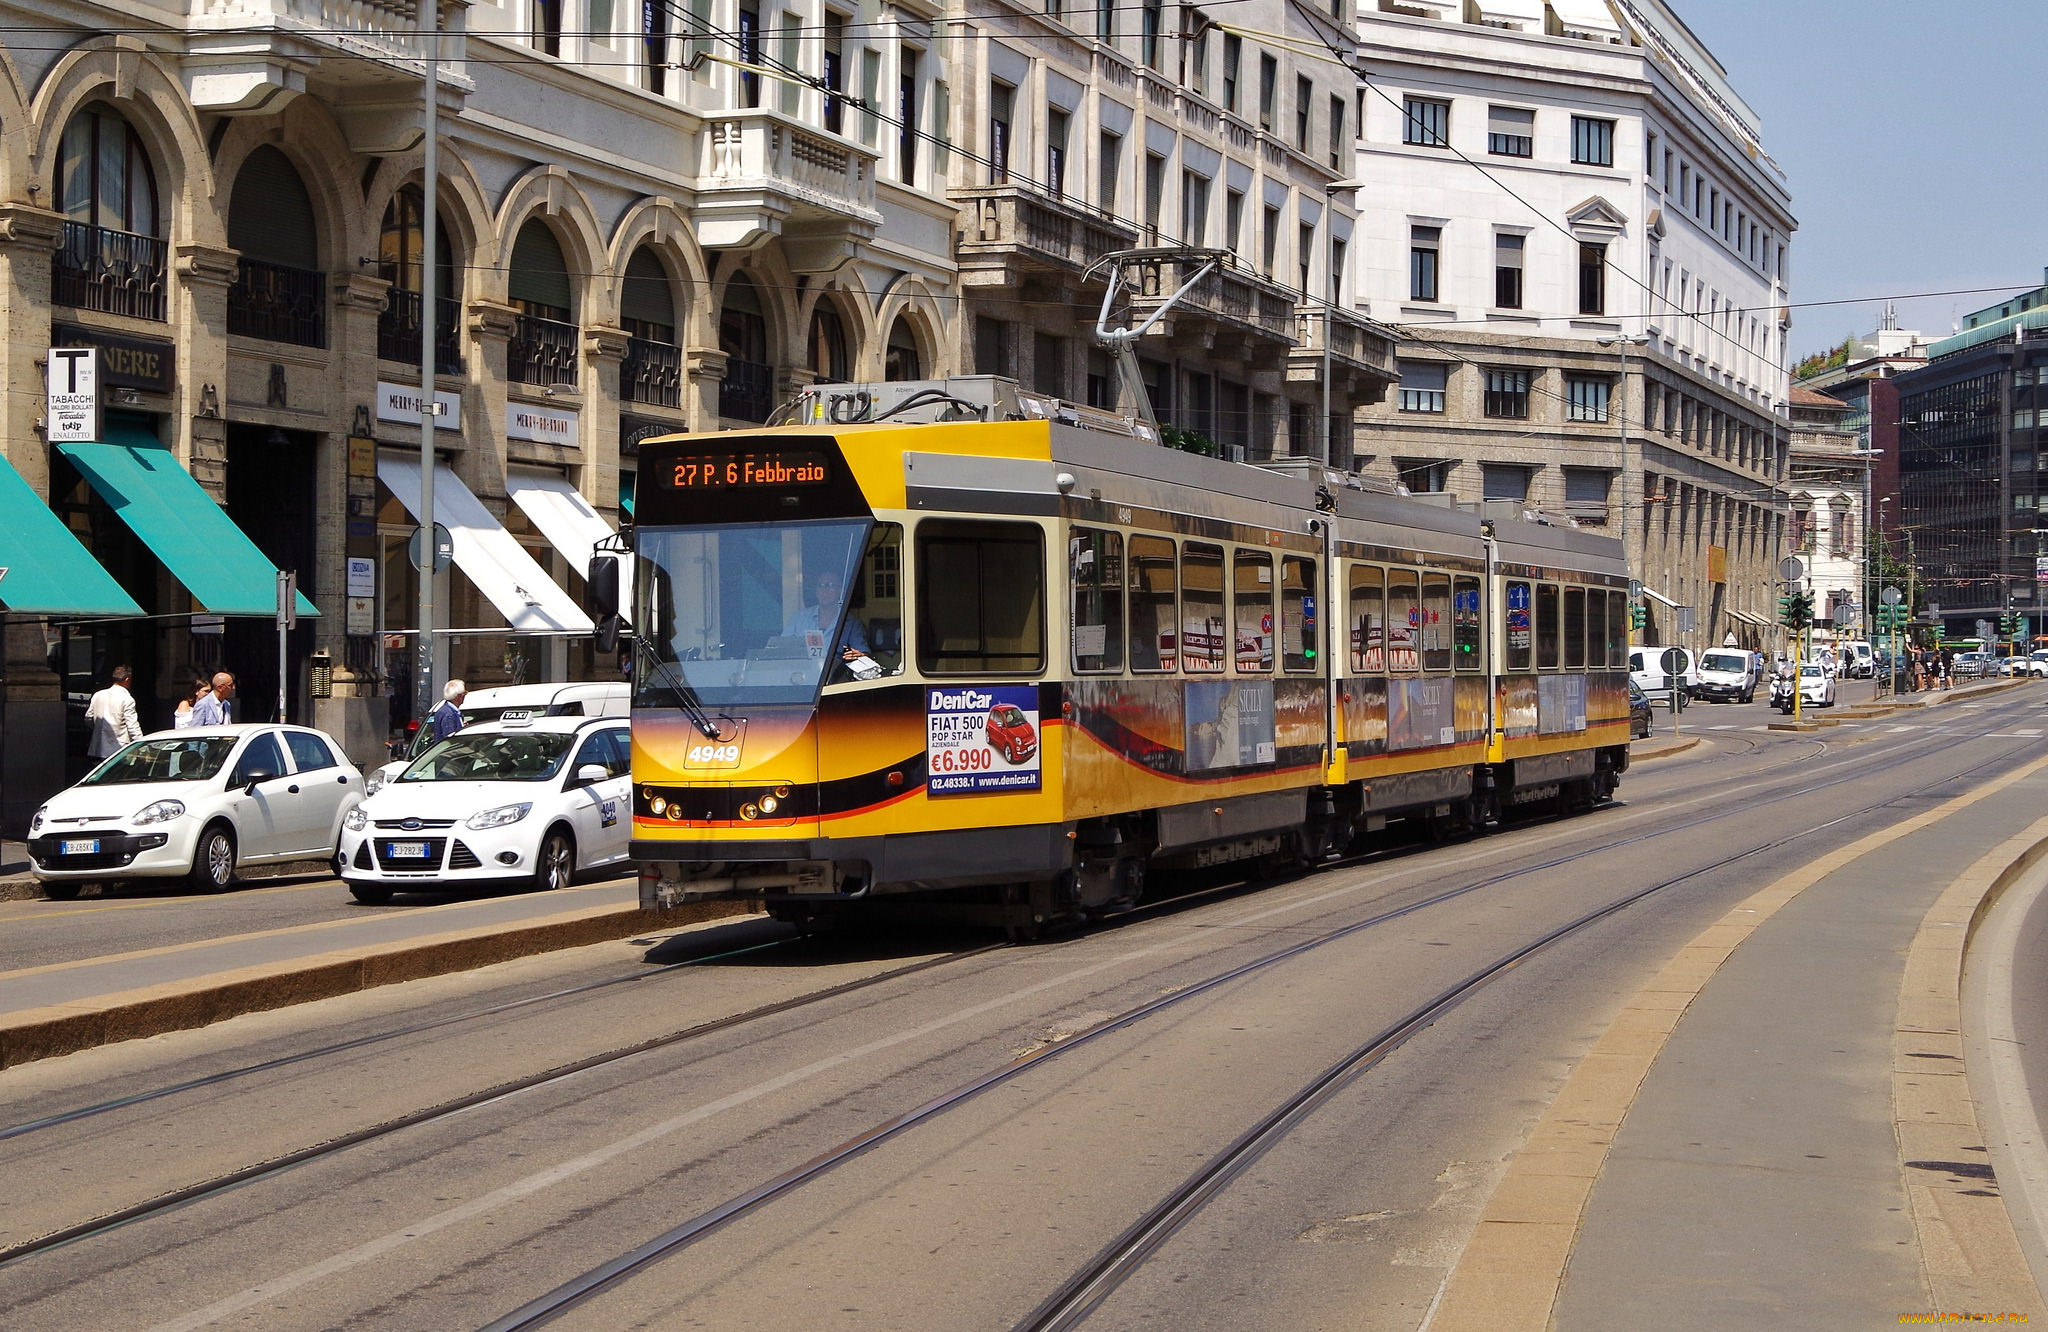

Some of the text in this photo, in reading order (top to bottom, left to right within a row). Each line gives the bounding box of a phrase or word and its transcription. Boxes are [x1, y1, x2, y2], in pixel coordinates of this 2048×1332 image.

[55, 351, 89, 393] T
[51, 395, 94, 404] TABACCHI
[62, 422, 82, 431] totip
[674, 461, 824, 486] 27 P. 6 Febbraio
[810, 647, 823, 657] 27
[930, 690, 992, 710] DeniCar
[1239, 688, 1263, 713] SICILY
[931, 715, 984, 731] FIAT 500
[931, 731, 974, 741] POP STAR
[688, 745, 739, 763] 4949
[931, 773, 1036, 790] 02.48338.1 www.denicar.it
